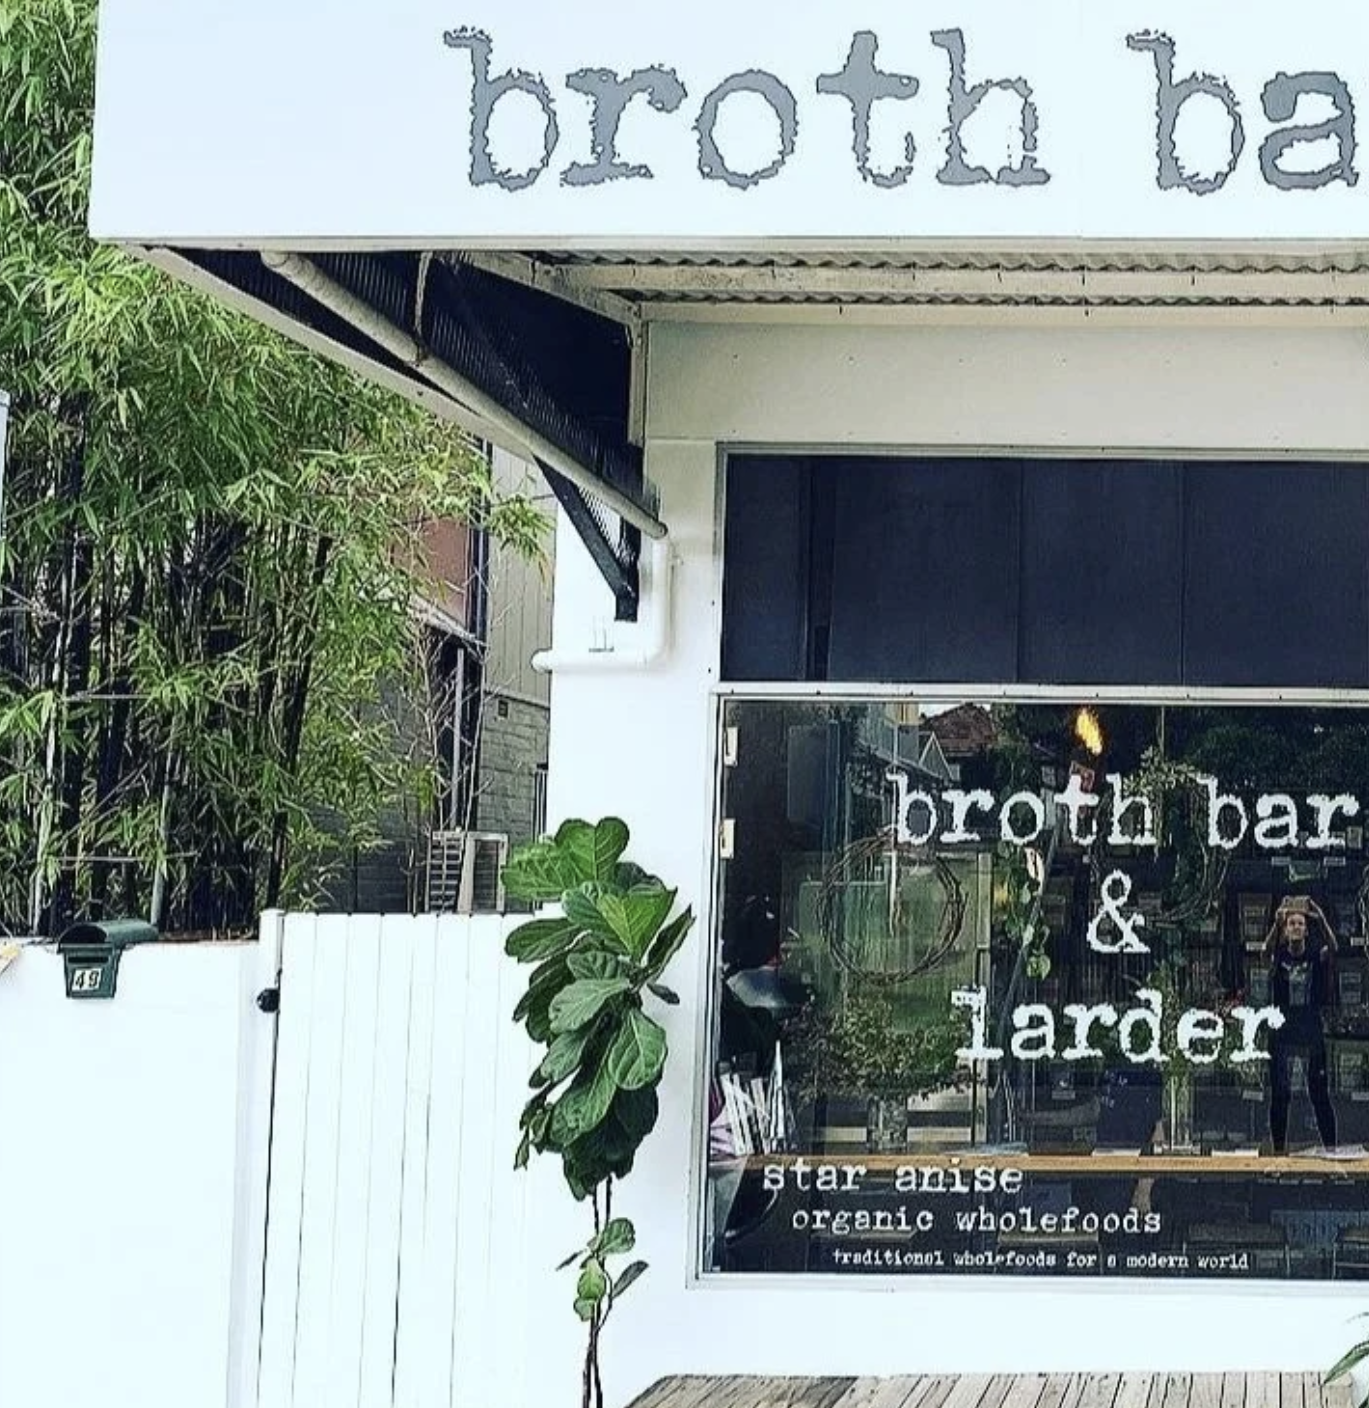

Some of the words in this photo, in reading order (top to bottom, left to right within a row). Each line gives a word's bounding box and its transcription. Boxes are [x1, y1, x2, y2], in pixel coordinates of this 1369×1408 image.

[443, 25, 1051, 191] broth
[886, 772, 1157, 847] broth
[1196, 774, 1361, 851] bar
[1086, 868, 1151, 955] &
[74, 970, 100, 989] 49
[950, 983, 1287, 1065] larder
[762, 1161, 868, 1193] star
[894, 1156, 1025, 1195] anise
[791, 1205, 934, 1235] organic
[955, 1207, 1163, 1234] wholefoods
[832, 1248, 945, 1266] traditional
[953, 1249, 1057, 1267] wholefoods
[1066, 1251, 1097, 1268] for
[1107, 1254, 1117, 1268] a
[1126, 1251, 1190, 1269] modern
[1197, 1252, 1250, 1270] world
